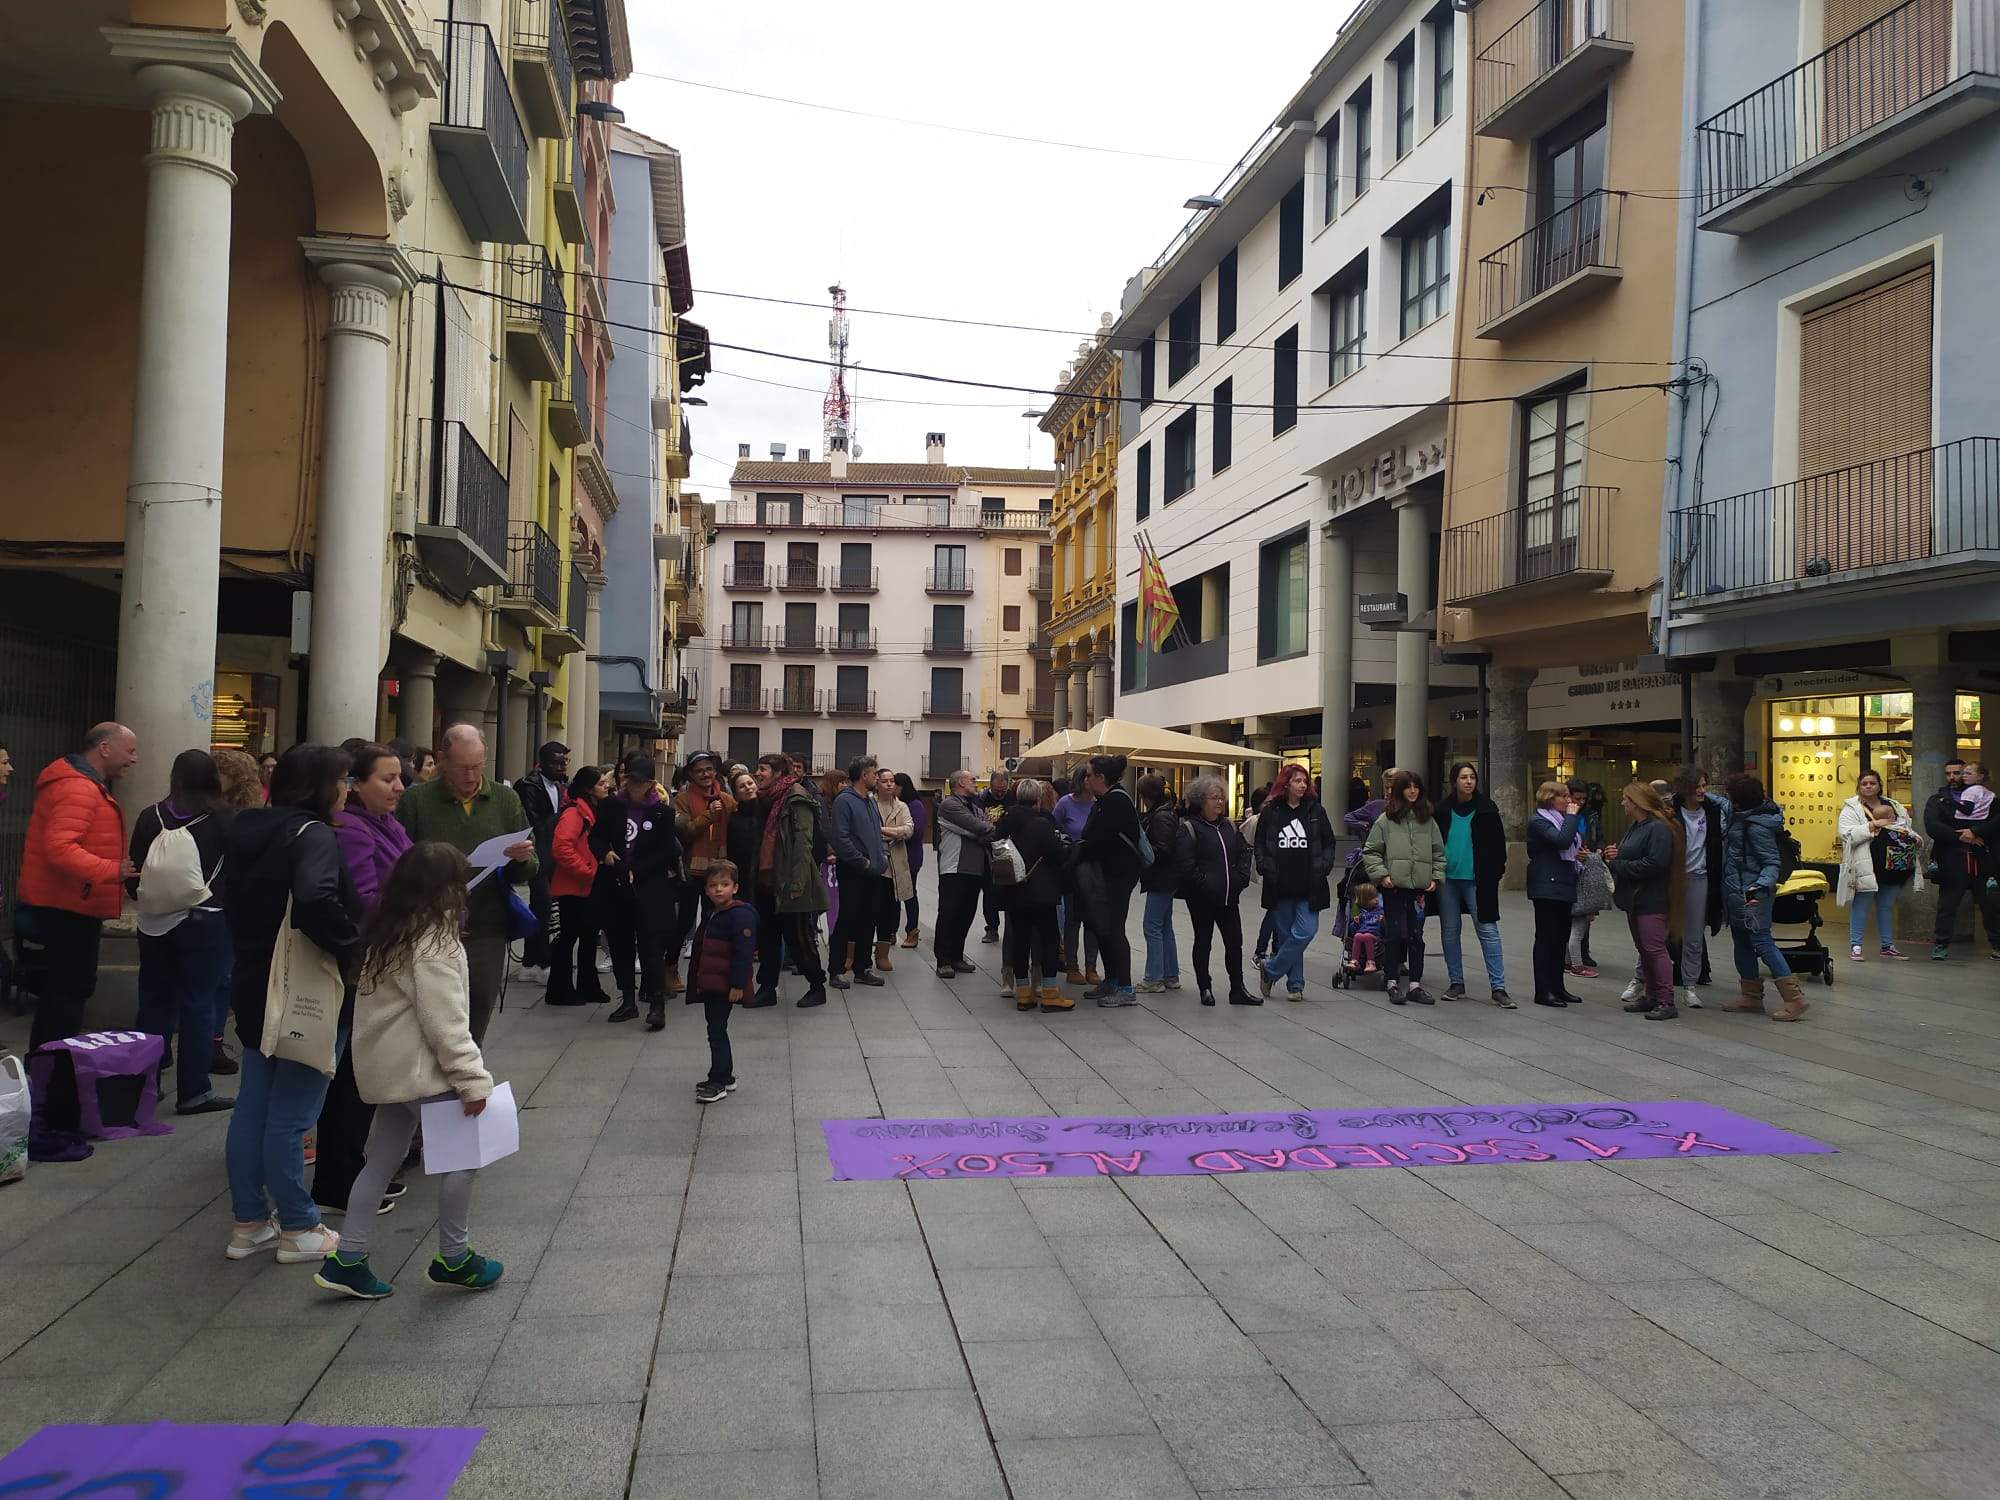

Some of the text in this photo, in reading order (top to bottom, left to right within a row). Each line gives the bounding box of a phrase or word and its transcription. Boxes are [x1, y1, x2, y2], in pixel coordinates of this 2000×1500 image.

[1328, 445, 1414, 511] HOTEL
[1360, 602, 1397, 612] RESTAURANTE
[1605, 679, 1620, 692] DE
[1622, 672, 1681, 692] BARBASTR
[1793, 674, 1860, 687] electricidad
[1569, 1136, 1622, 1158] 1
[1642, 1132, 1737, 1153] X
[891, 1151, 1053, 1179] 50%
[1058, 1150, 1147, 1175] AL
